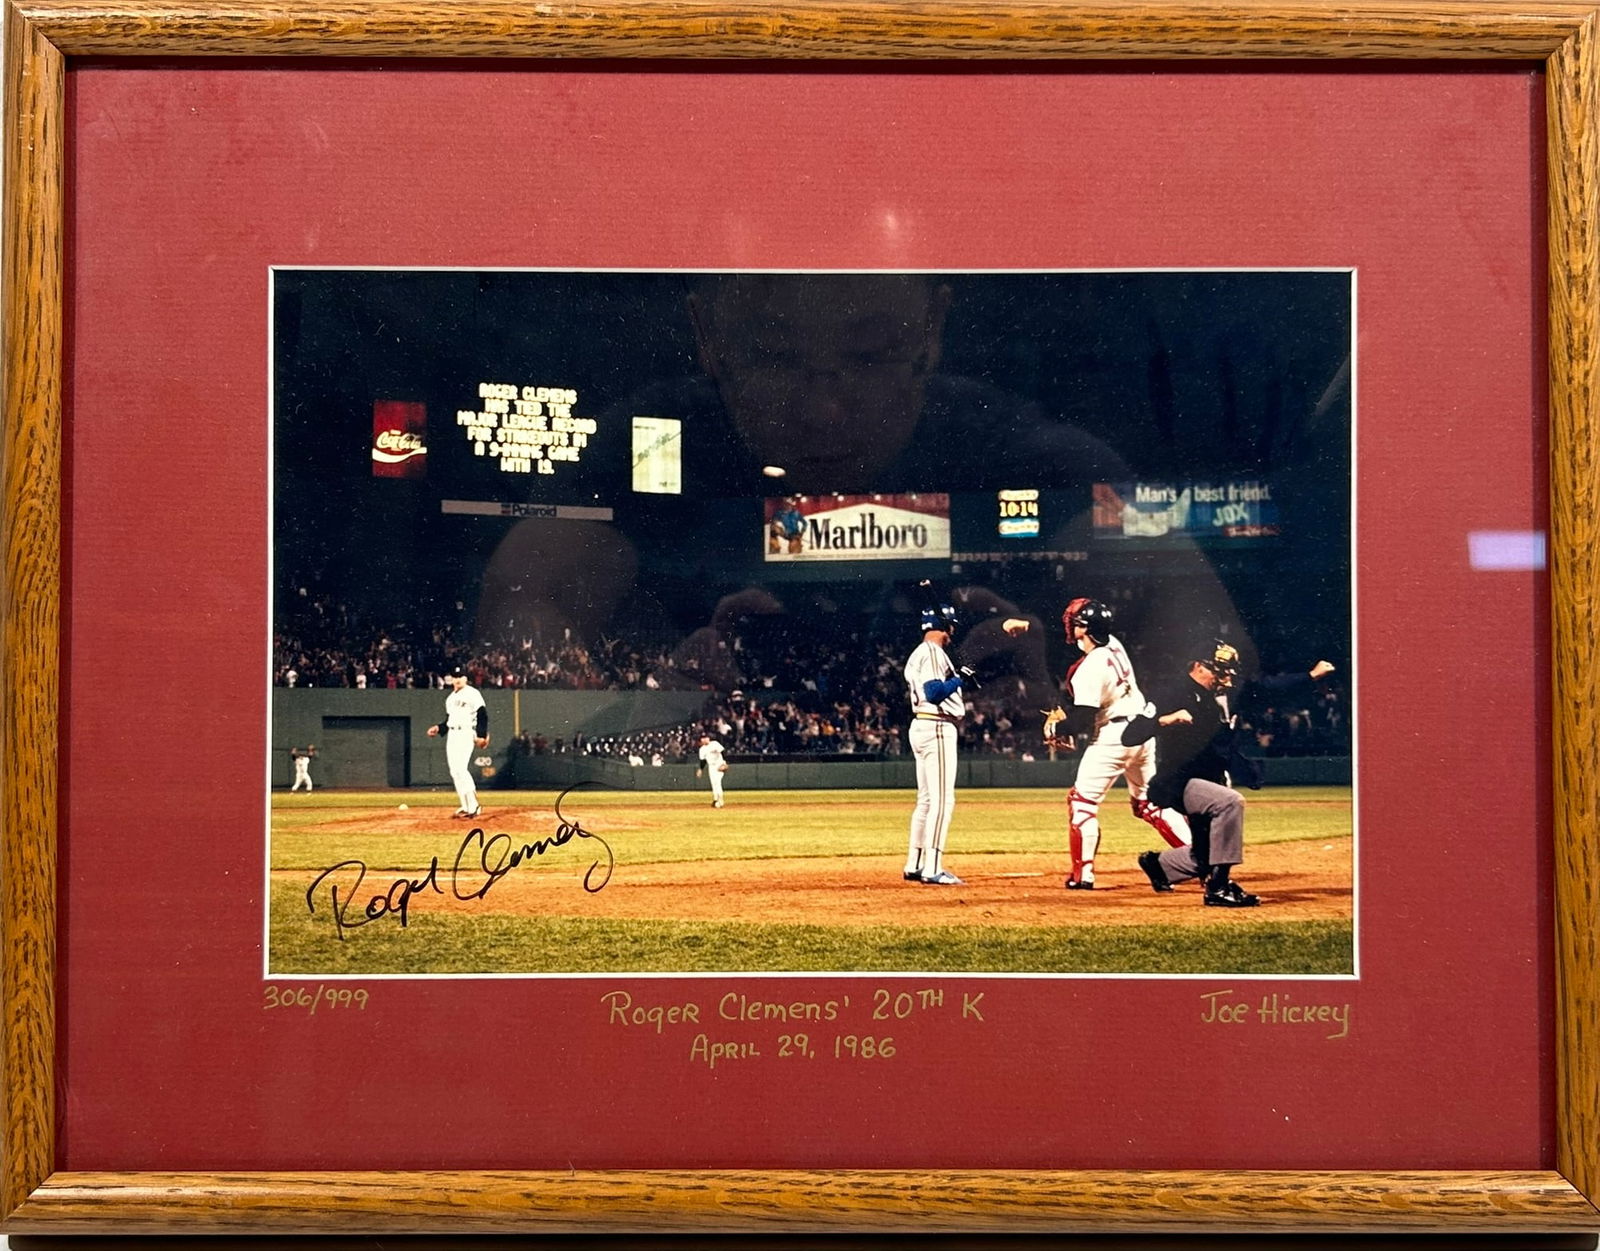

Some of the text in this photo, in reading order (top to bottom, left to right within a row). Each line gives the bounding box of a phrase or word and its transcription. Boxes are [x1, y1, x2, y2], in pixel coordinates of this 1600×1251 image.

[522, 386, 577, 404] CLEMENS
[1135, 486, 1177, 502] Man's
[1194, 485, 1224, 500] best
[512, 503, 557, 518] Polaroid
[809, 512, 928, 550] Marlboro
[263, 984, 369, 1015] 306/999
[961, 992, 985, 1021] K
[1200, 989, 1350, 1039] Joe Hickey
[835, 1036, 897, 1058] 1986
